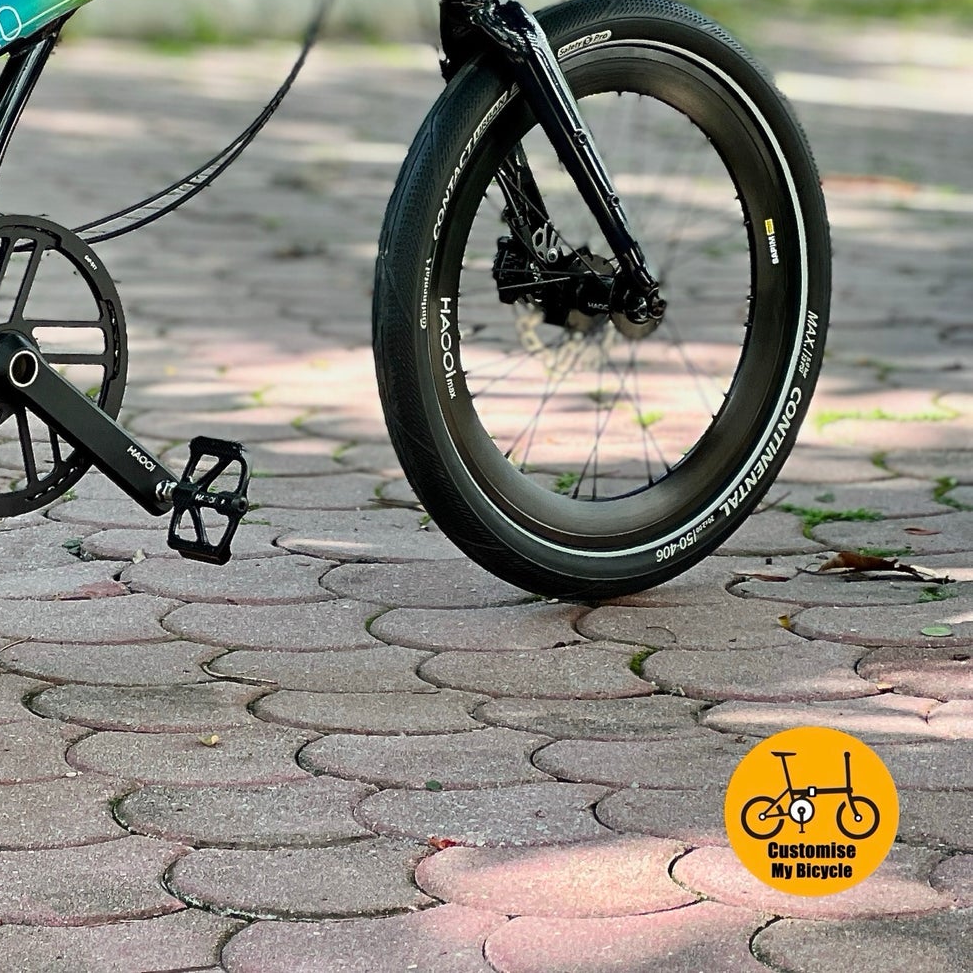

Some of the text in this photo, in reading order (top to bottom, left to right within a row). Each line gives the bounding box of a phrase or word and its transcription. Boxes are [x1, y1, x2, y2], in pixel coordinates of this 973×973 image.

[433, 138, 473, 240] CONTACT
[446, 378, 457, 400] max
[719, 387, 802, 517] CONTINENTAL
